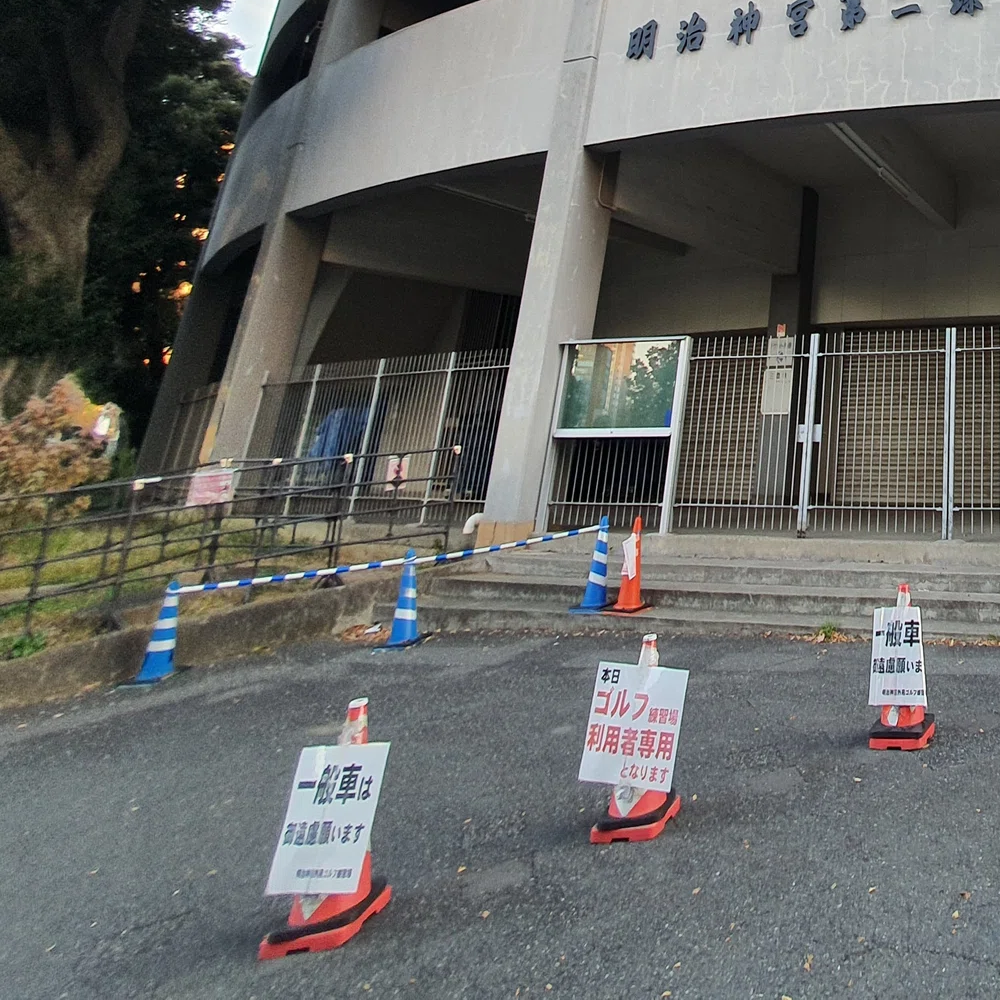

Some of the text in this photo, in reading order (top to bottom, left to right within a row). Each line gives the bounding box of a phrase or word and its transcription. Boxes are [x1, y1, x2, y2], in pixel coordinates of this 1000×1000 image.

[875, 619, 920, 647] 一般車
[601, 667, 621, 684] 本日
[594, 687, 679, 726] ゴルフ練習場
[587, 722, 675, 761] 利用者専用
[297, 763, 373, 805] 一般車は
[620, 763, 669, 784] となります
